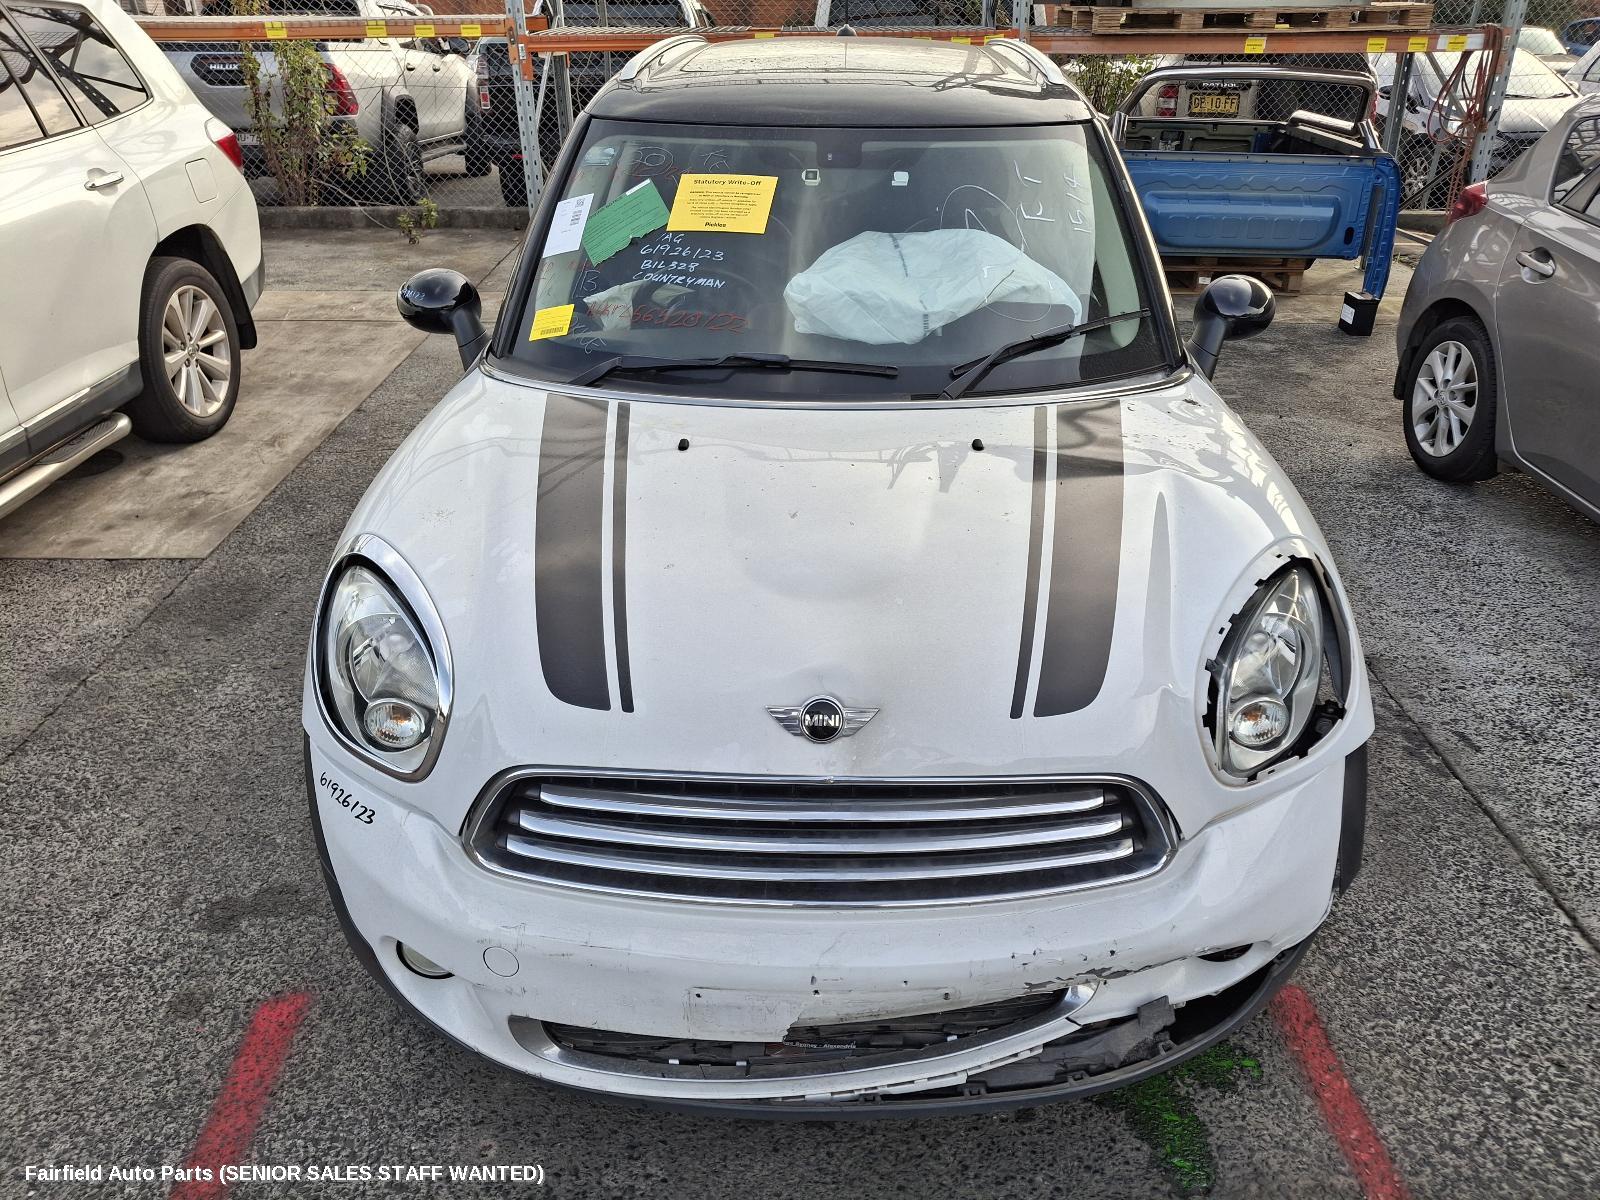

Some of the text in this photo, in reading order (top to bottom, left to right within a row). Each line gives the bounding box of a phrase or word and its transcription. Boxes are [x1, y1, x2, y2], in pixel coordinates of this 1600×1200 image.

[209, 63, 240, 71] HILUX
[640, 243, 725, 262] 61926123
[632, 272, 727, 289] COUNTRYMAN
[804, 714, 840, 727] MINI
[319, 771, 377, 825] 61926123
